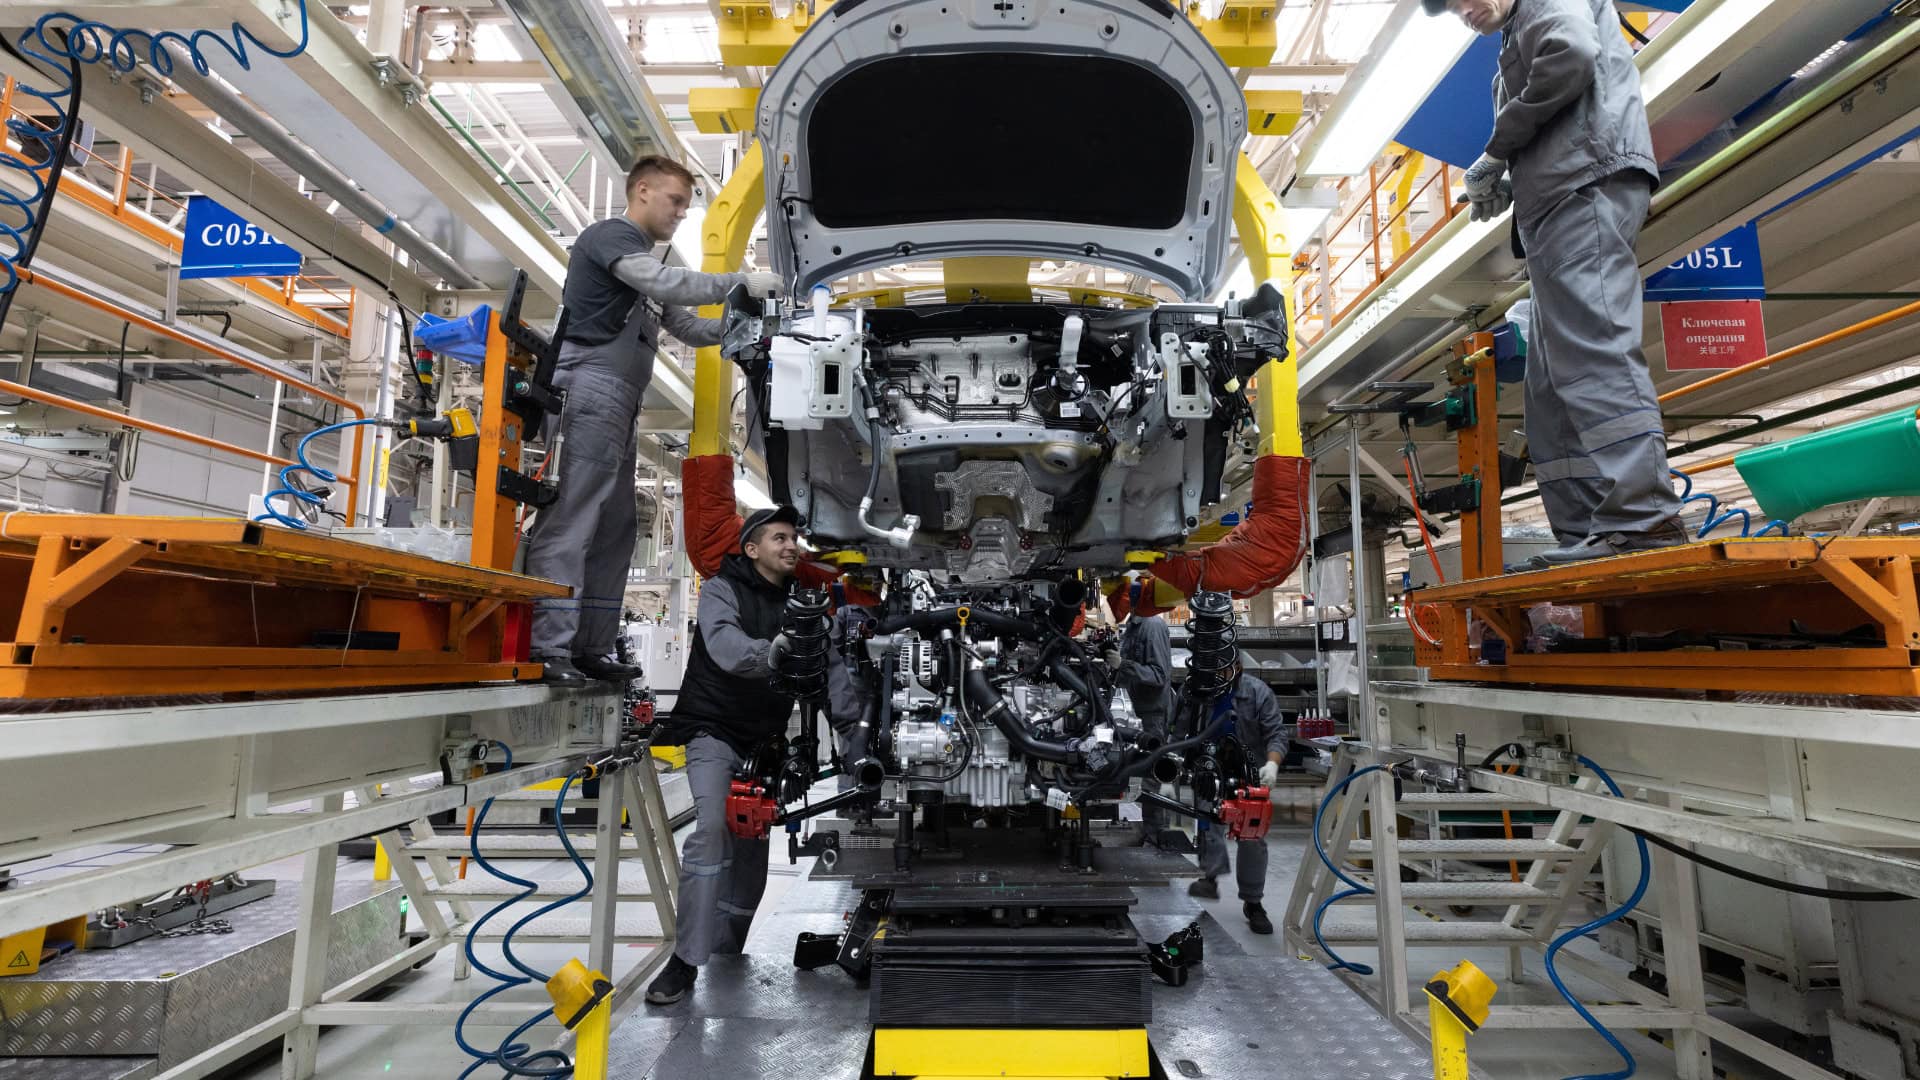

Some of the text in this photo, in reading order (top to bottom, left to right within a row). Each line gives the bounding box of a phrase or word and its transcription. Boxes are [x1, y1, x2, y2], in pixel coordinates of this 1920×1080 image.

[1682, 317, 1746, 328] Ключевая
[1686, 334, 1745, 345] операция
[1700, 345, 1736, 355] 关键工序
